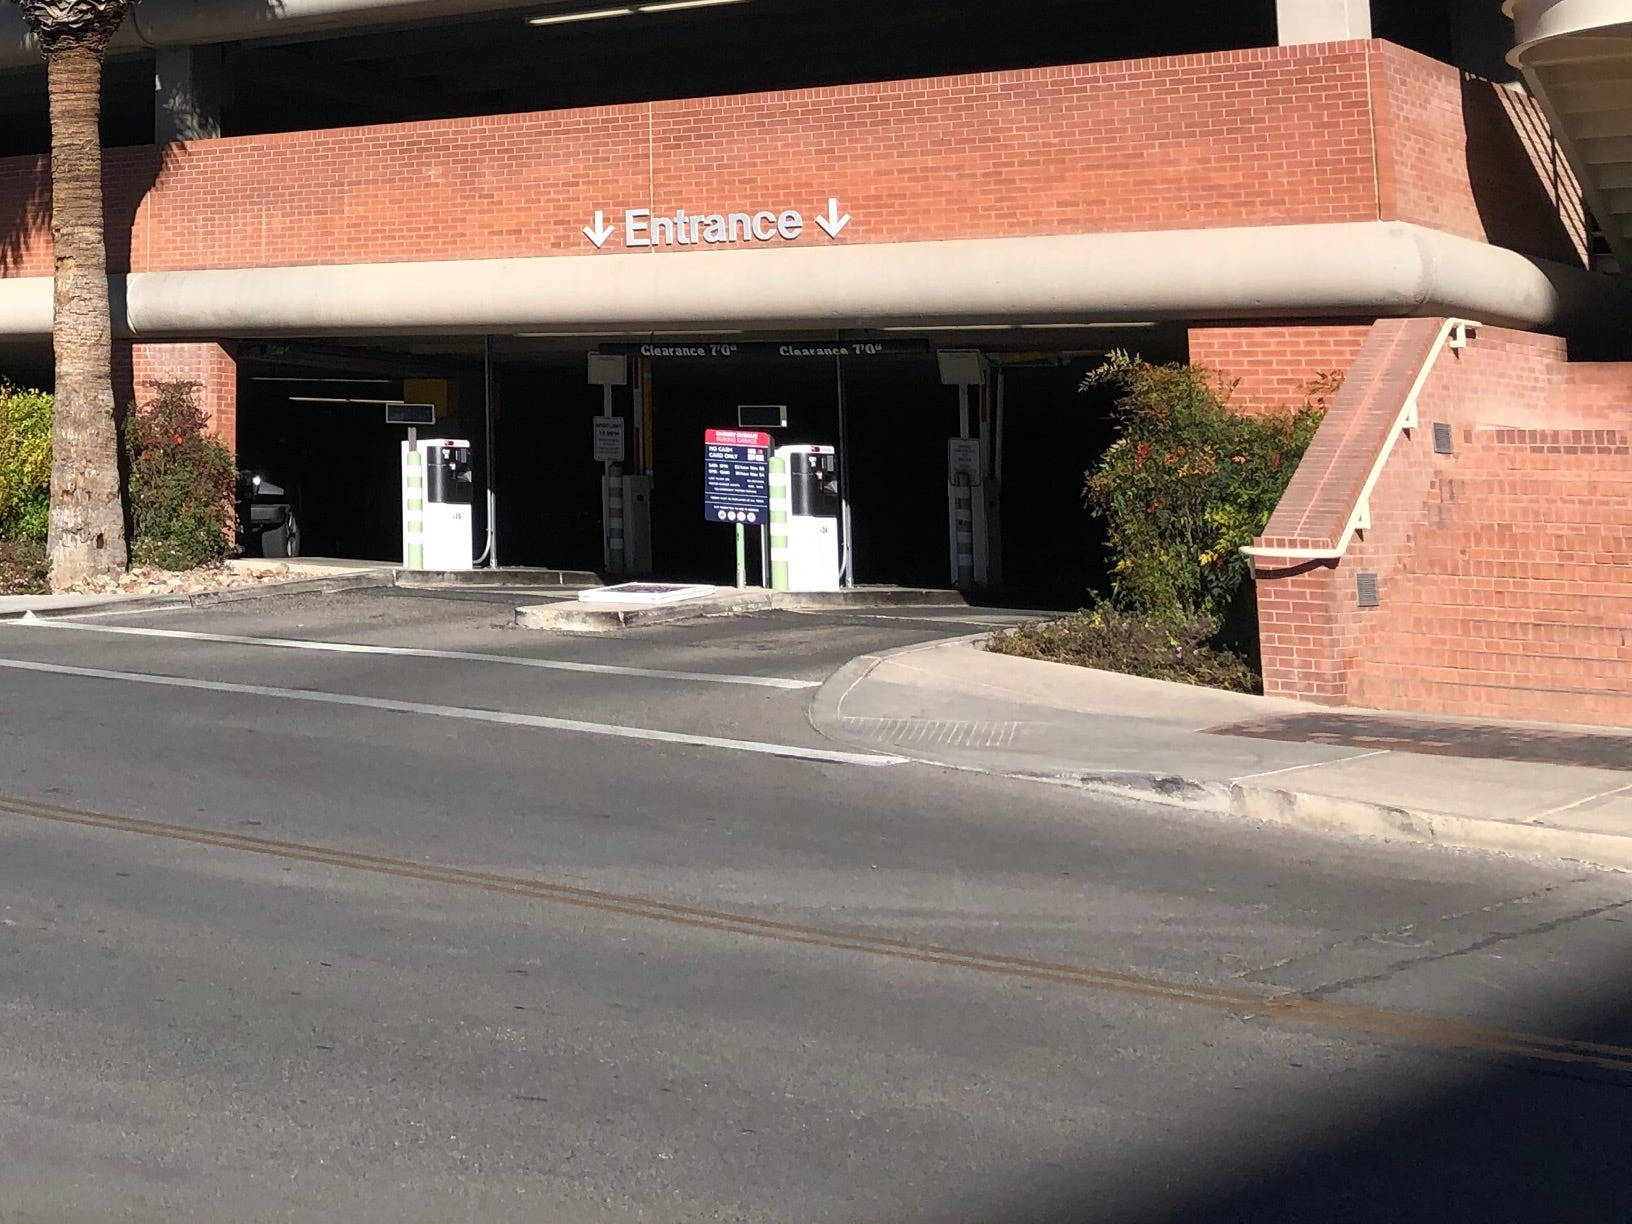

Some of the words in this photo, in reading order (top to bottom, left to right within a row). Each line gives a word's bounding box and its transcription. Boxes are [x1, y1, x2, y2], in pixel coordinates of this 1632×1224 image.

[625, 208, 803, 247] Entrance
[640, 344, 706, 356] Clearance
[779, 345, 849, 356] Clearance
